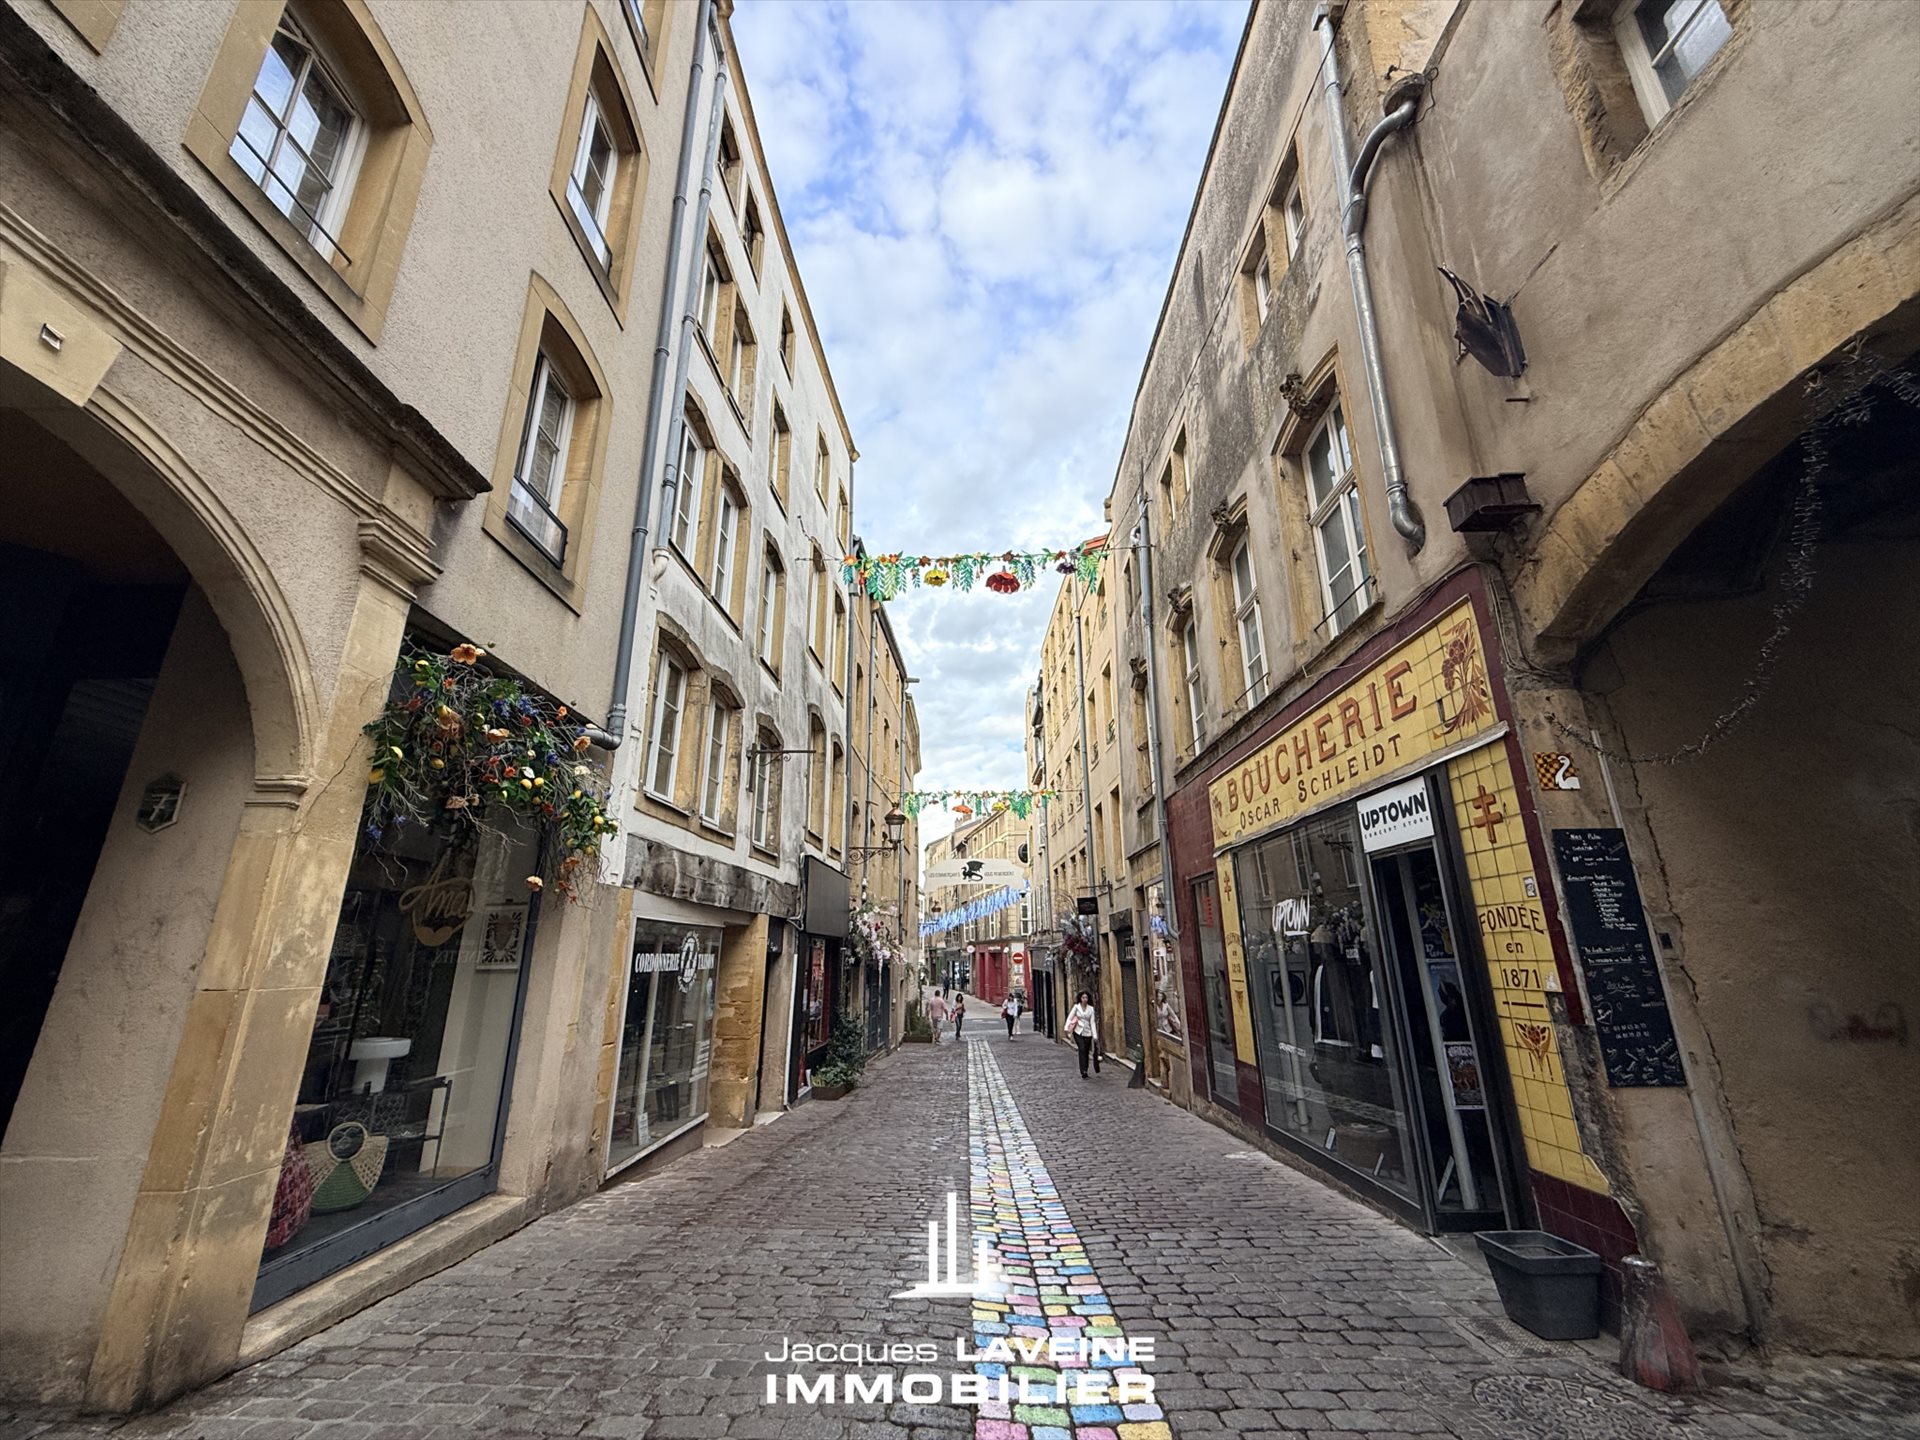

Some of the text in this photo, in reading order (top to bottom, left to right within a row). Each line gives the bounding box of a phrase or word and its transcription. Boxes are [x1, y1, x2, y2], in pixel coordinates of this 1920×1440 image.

[1227, 660, 1418, 813] BOUCHERIE
[1240, 733, 1402, 830] OSCAR SCHLEIDT
[1361, 791, 1427, 831] UPTOWN
[1272, 890, 1310, 936] UPTOWN
[1478, 904, 1545, 937] FONDÉE
[635, 952, 681, 973] CORDONNERIE
[1506, 941, 1524, 954] en
[1502, 968, 1541, 989] 1871
